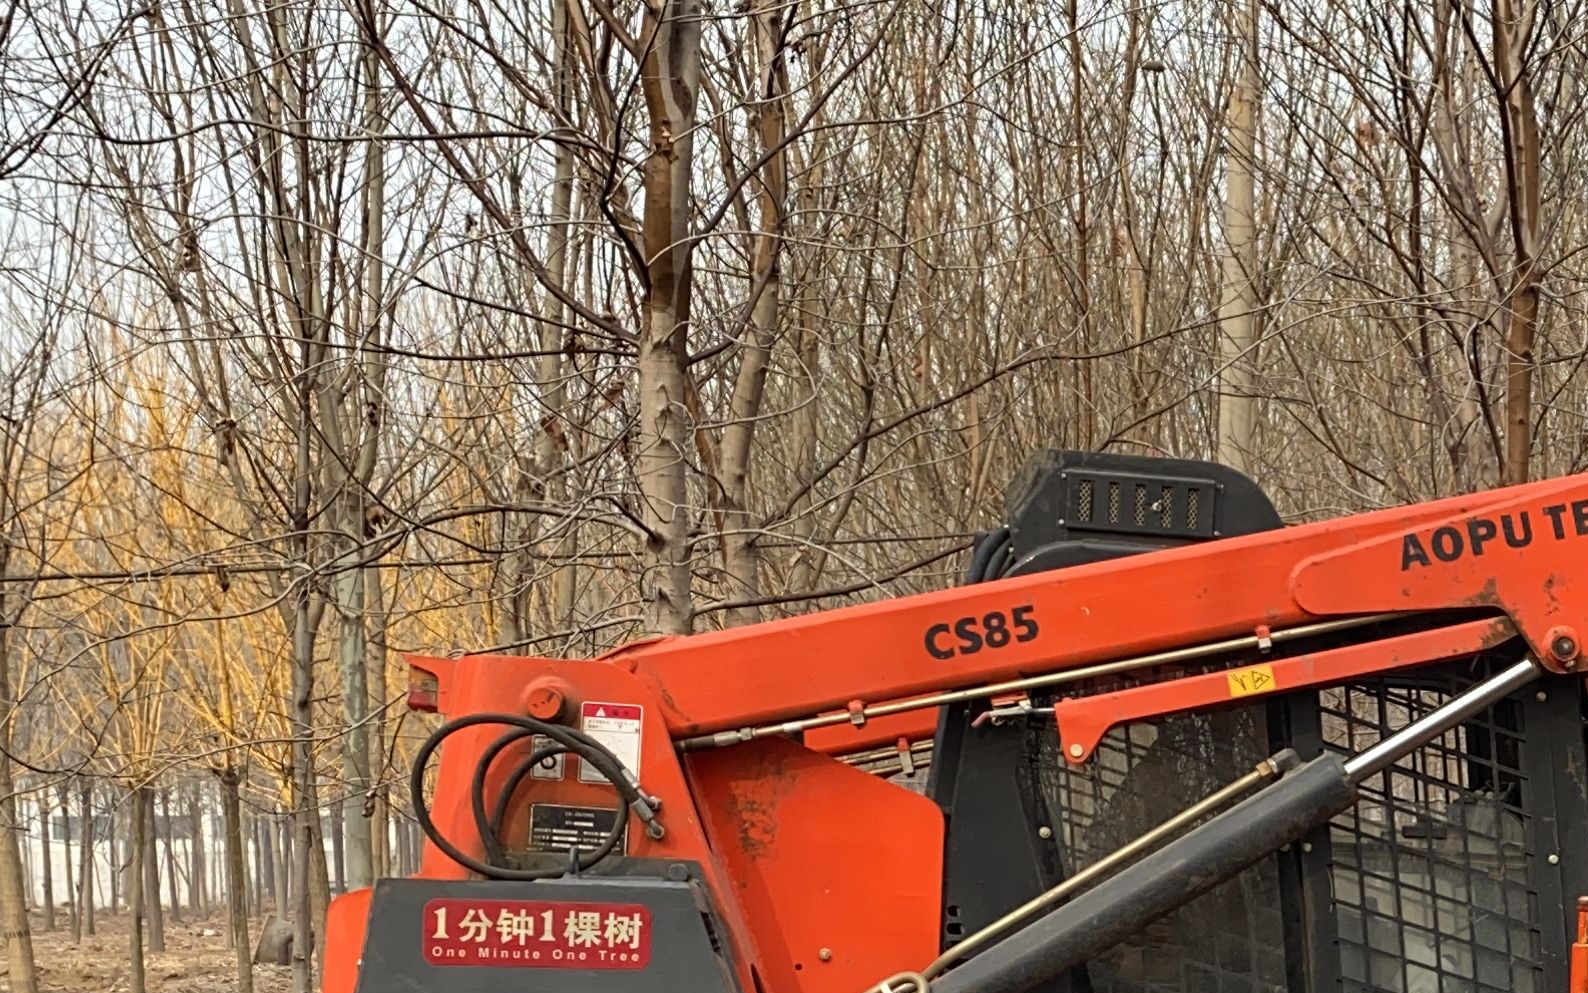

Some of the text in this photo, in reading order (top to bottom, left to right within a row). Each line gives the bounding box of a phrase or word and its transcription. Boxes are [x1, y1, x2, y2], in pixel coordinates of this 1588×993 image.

[1401, 511, 1533, 571] AOPU
[924, 604, 1039, 660] CS85
[432, 907, 643, 949] 1分钟1棵树
[432, 946, 640, 962] One Minute One Tree
